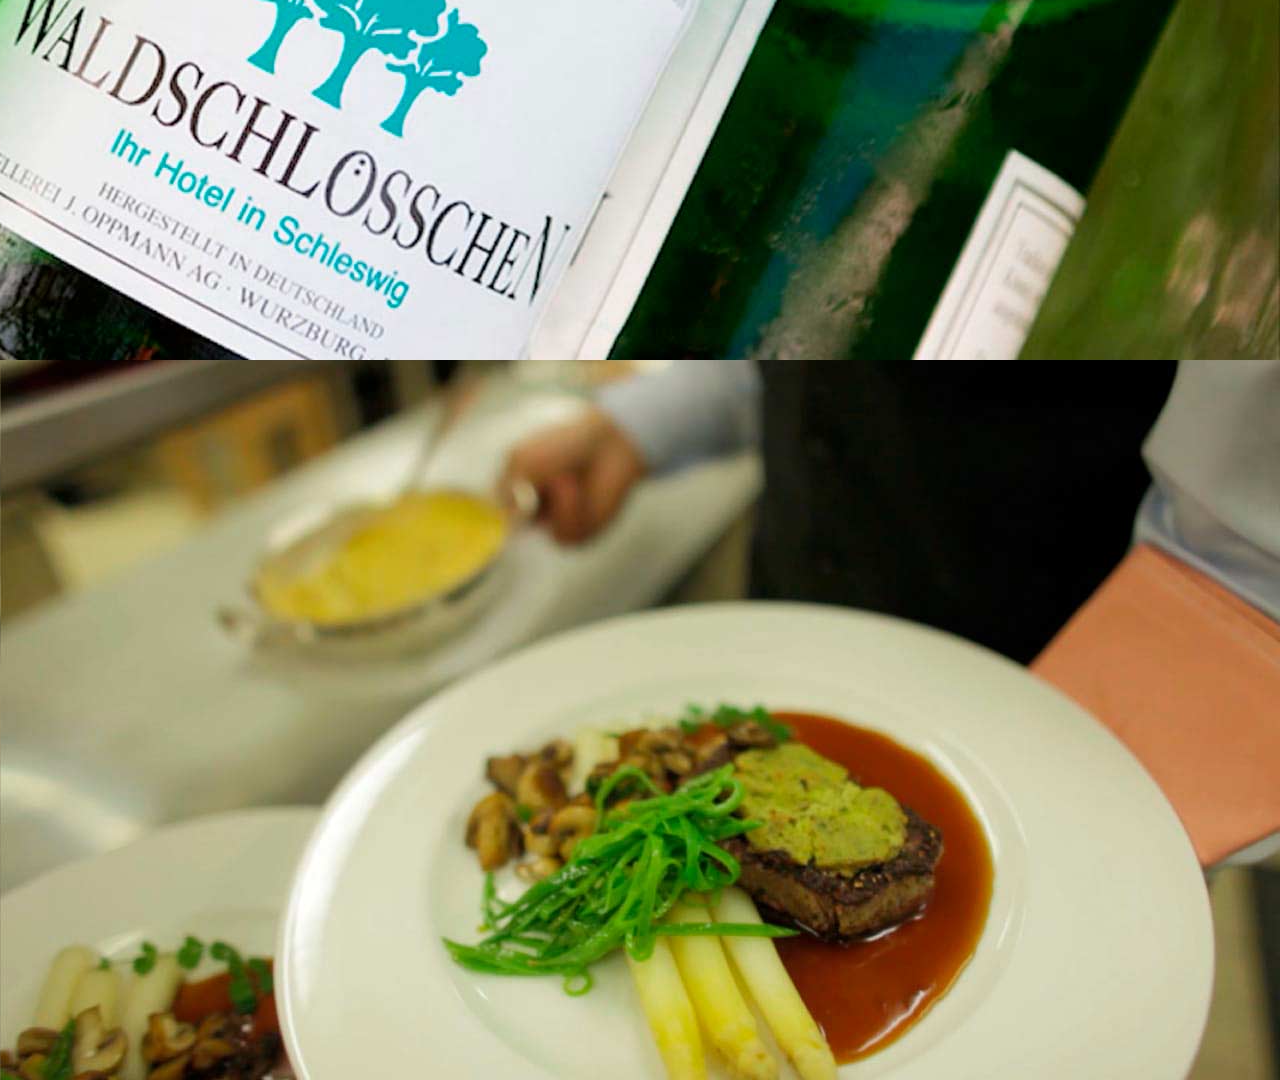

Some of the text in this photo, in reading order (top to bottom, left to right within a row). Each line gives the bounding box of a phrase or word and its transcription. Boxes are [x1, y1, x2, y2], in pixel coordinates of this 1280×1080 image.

[63, 195, 77, 217] J.
[81, 204, 188, 271] OPPMANN
[187, 263, 222, 292] AG
[98, 182, 384, 340] HERGESTELLT IN DEUTSCHLAND
[110, 127, 410, 309] Ihr Hotel in Schleswig
